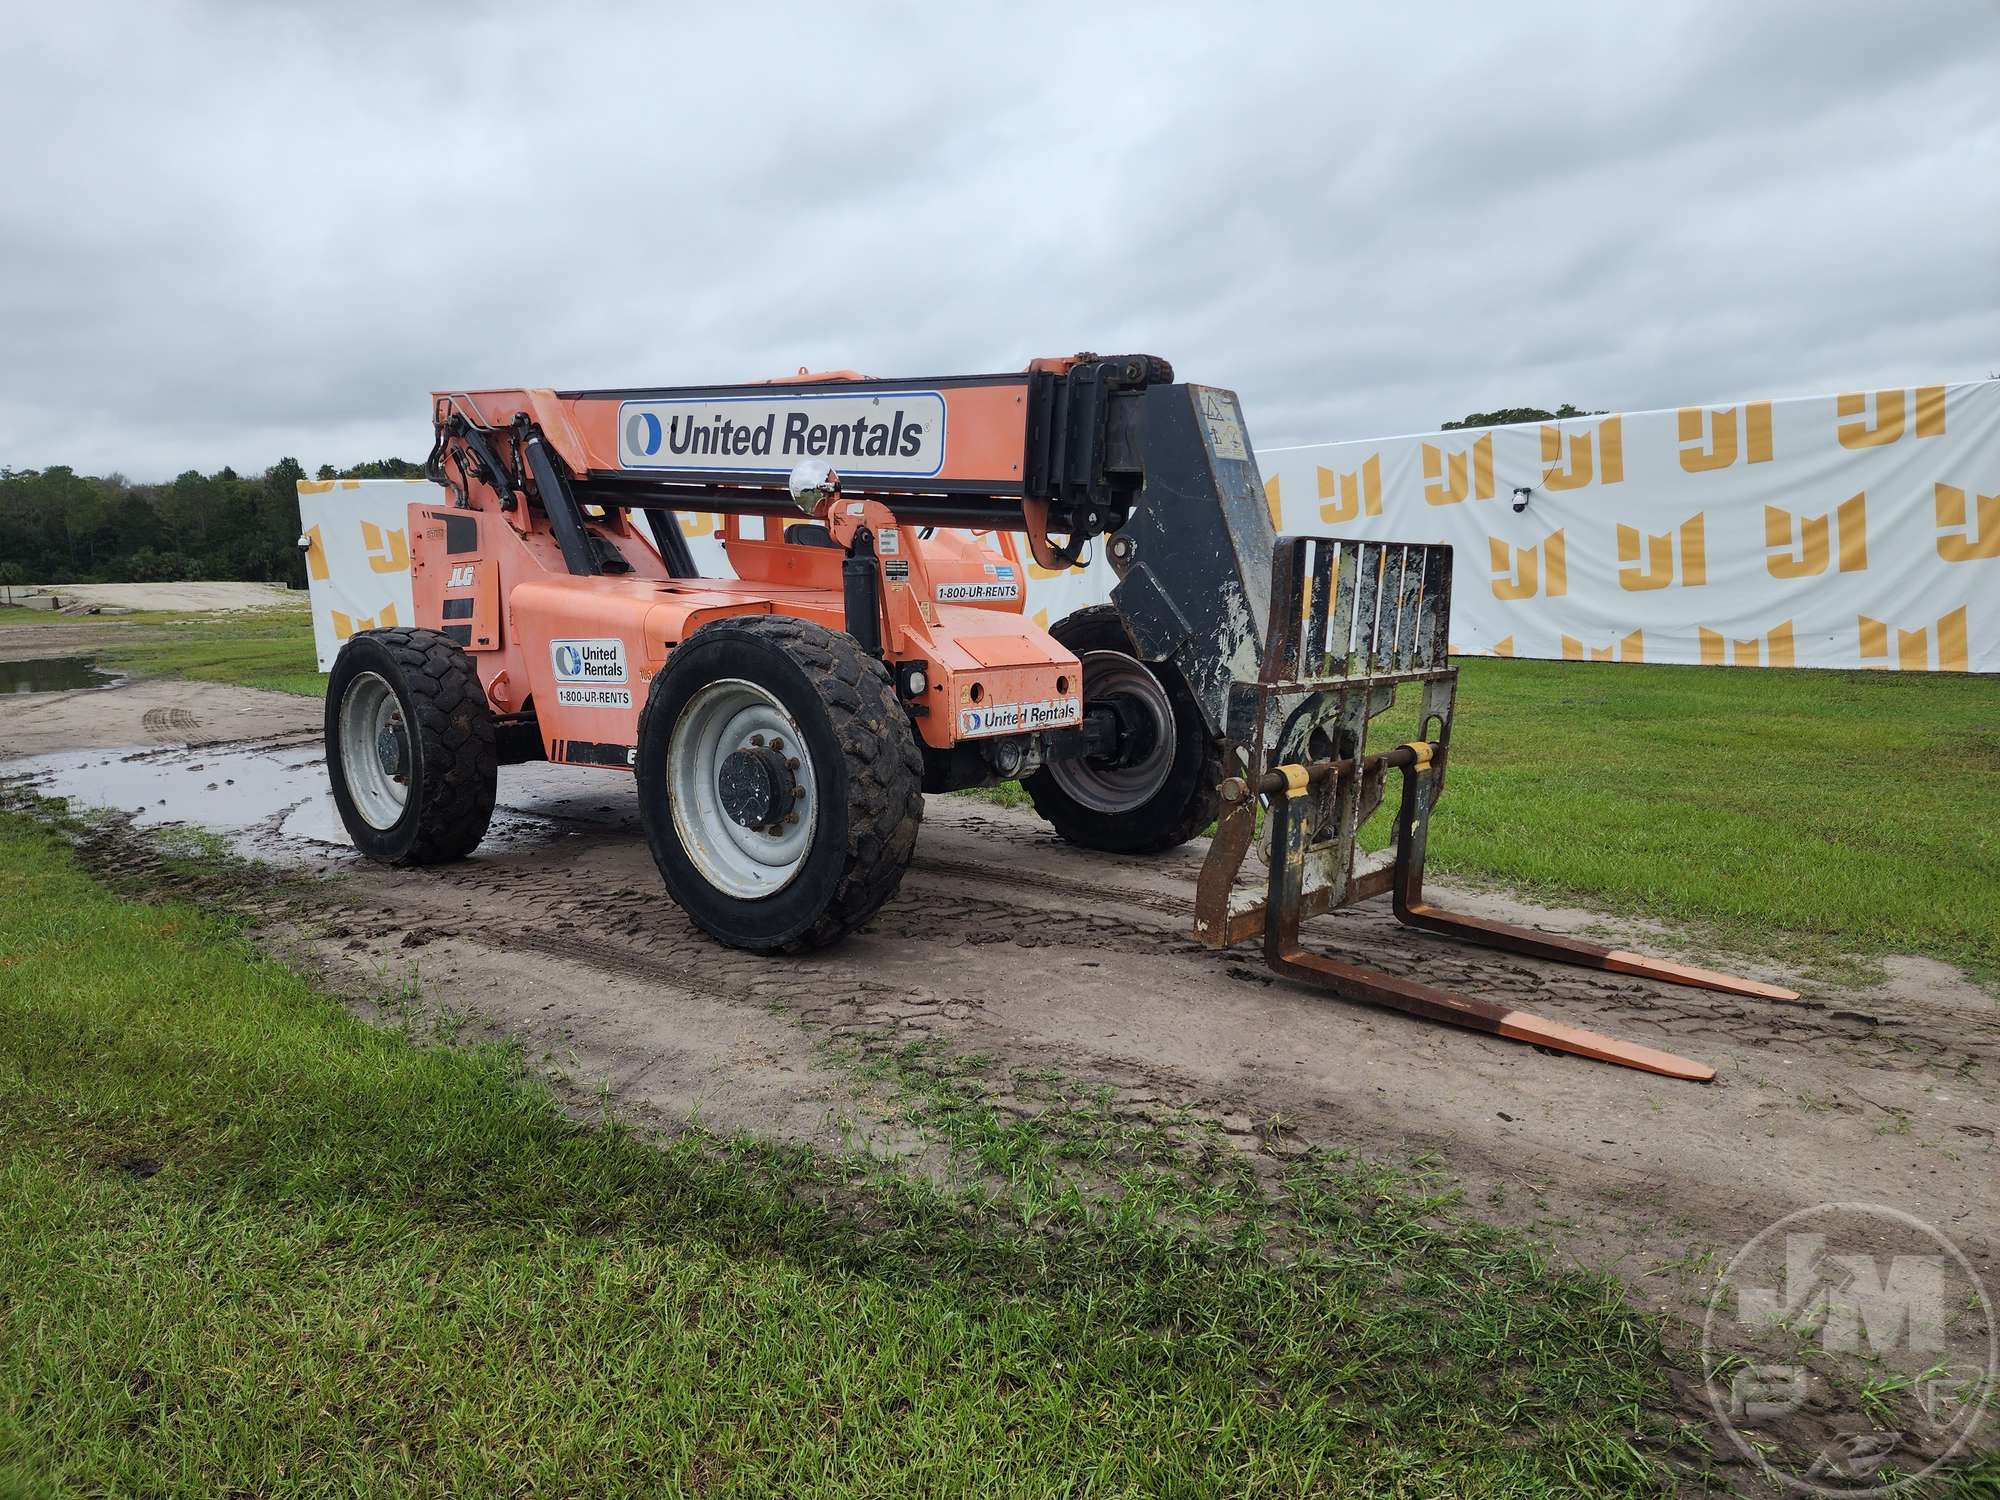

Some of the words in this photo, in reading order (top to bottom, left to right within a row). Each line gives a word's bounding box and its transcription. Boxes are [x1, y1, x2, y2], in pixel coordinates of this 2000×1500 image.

[669, 413, 776, 456] United
[782, 410, 923, 457] Rentals
[447, 565, 475, 588] JLG
[938, 585, 1017, 599] 1-800-UR-RENTS
[582, 646, 617, 661] United
[584, 662, 623, 677] Rentals
[559, 691, 629, 704] 1-800-UR-RENTS
[985, 708, 1027, 728] United
[1031, 704, 1075, 722] Rentals
